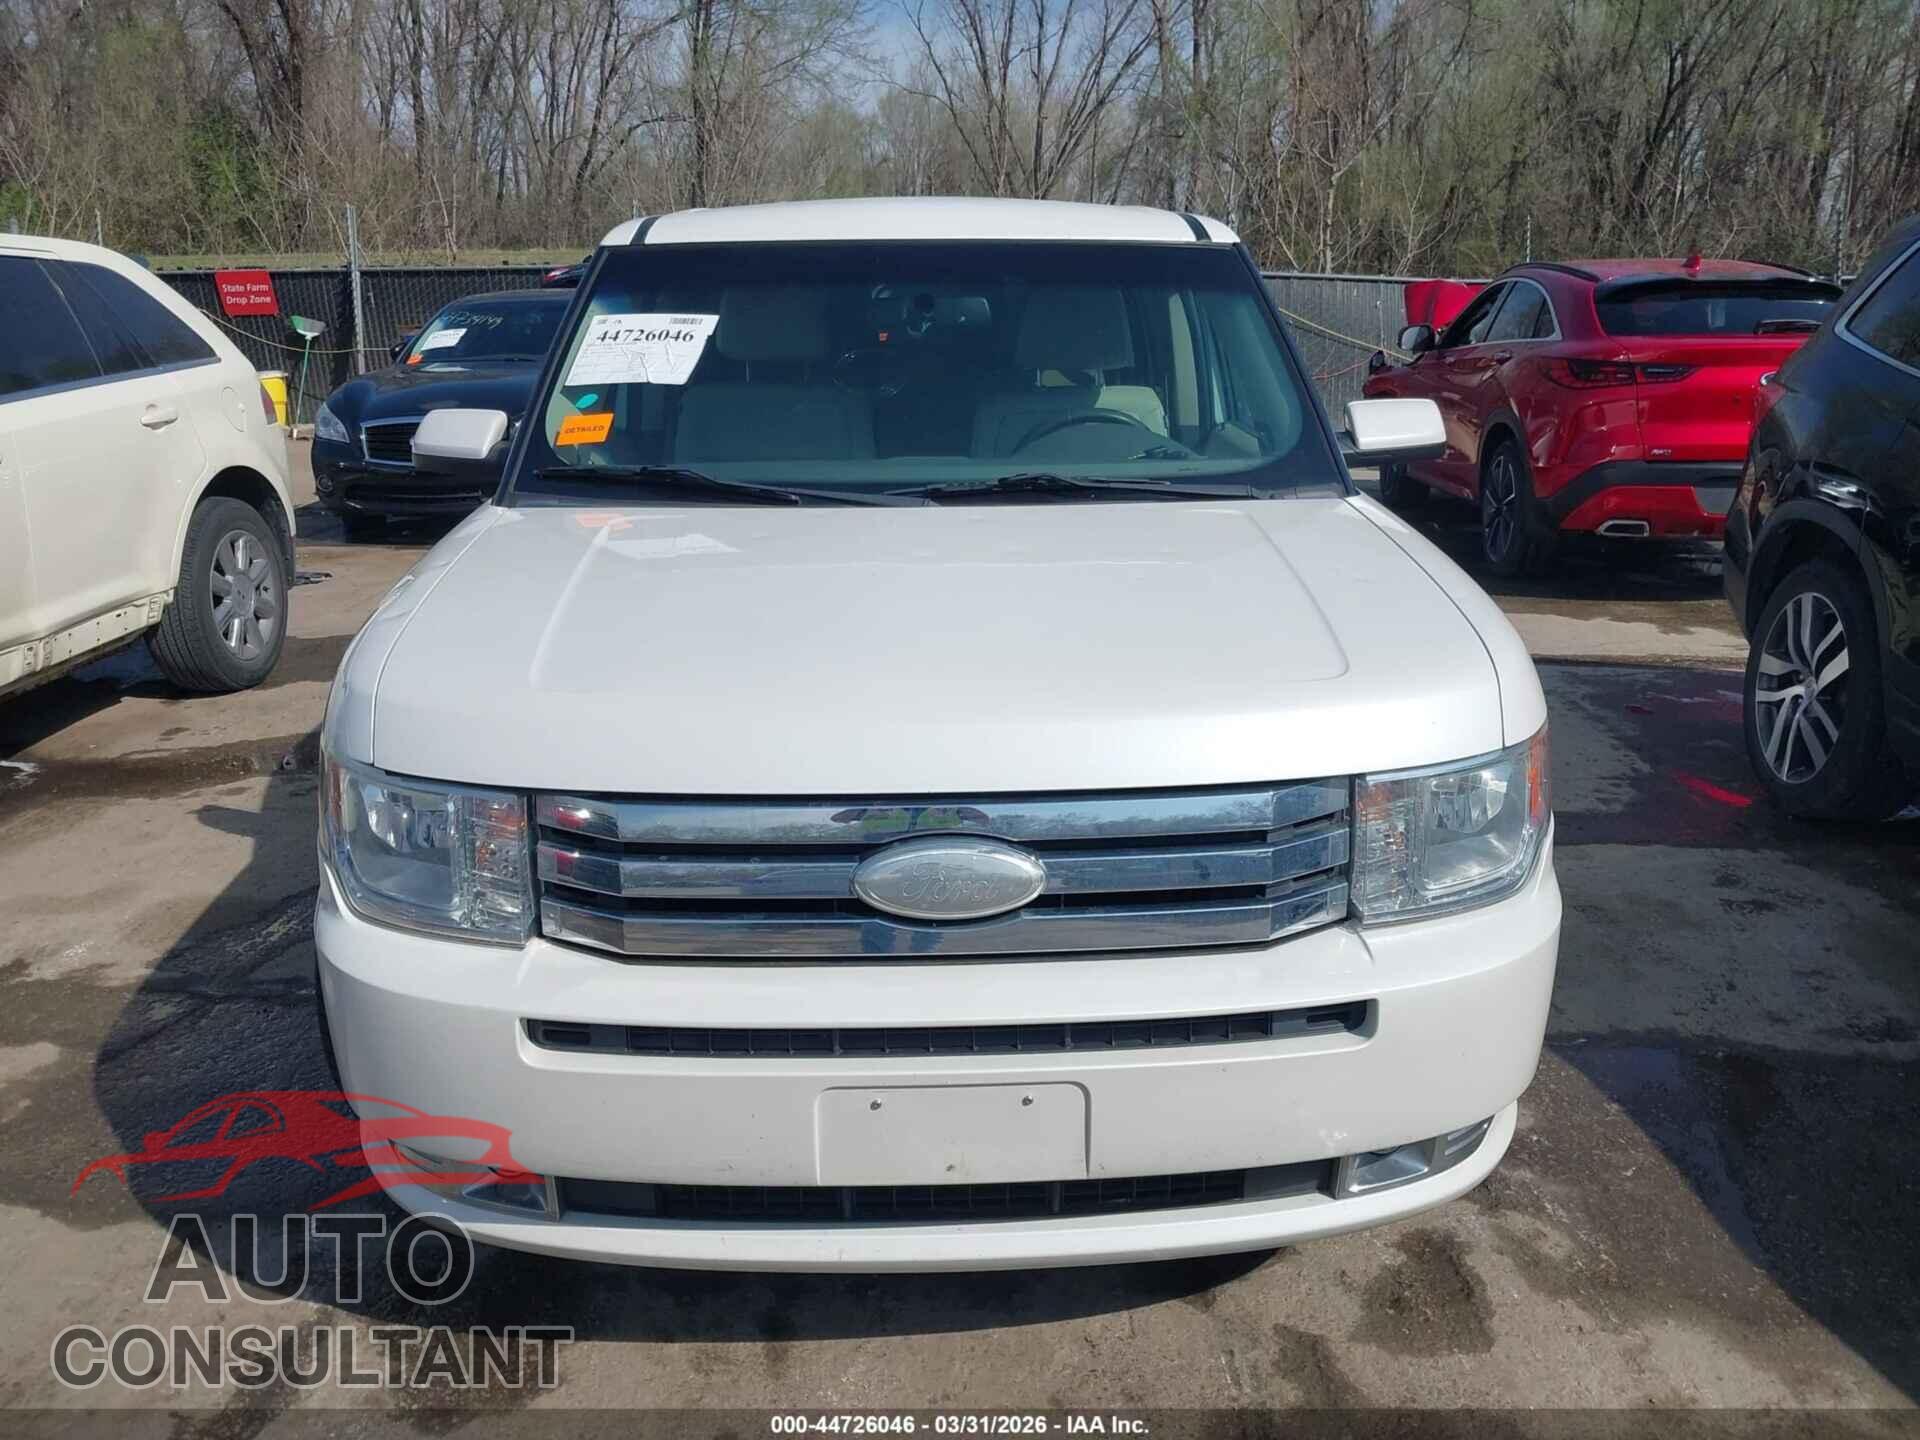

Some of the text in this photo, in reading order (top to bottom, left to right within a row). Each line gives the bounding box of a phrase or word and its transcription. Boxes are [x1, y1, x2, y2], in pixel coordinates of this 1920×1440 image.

[222, 284, 245, 292] State
[226, 296, 272, 305] Drop Zone
[597, 328, 697, 343] 44726046
